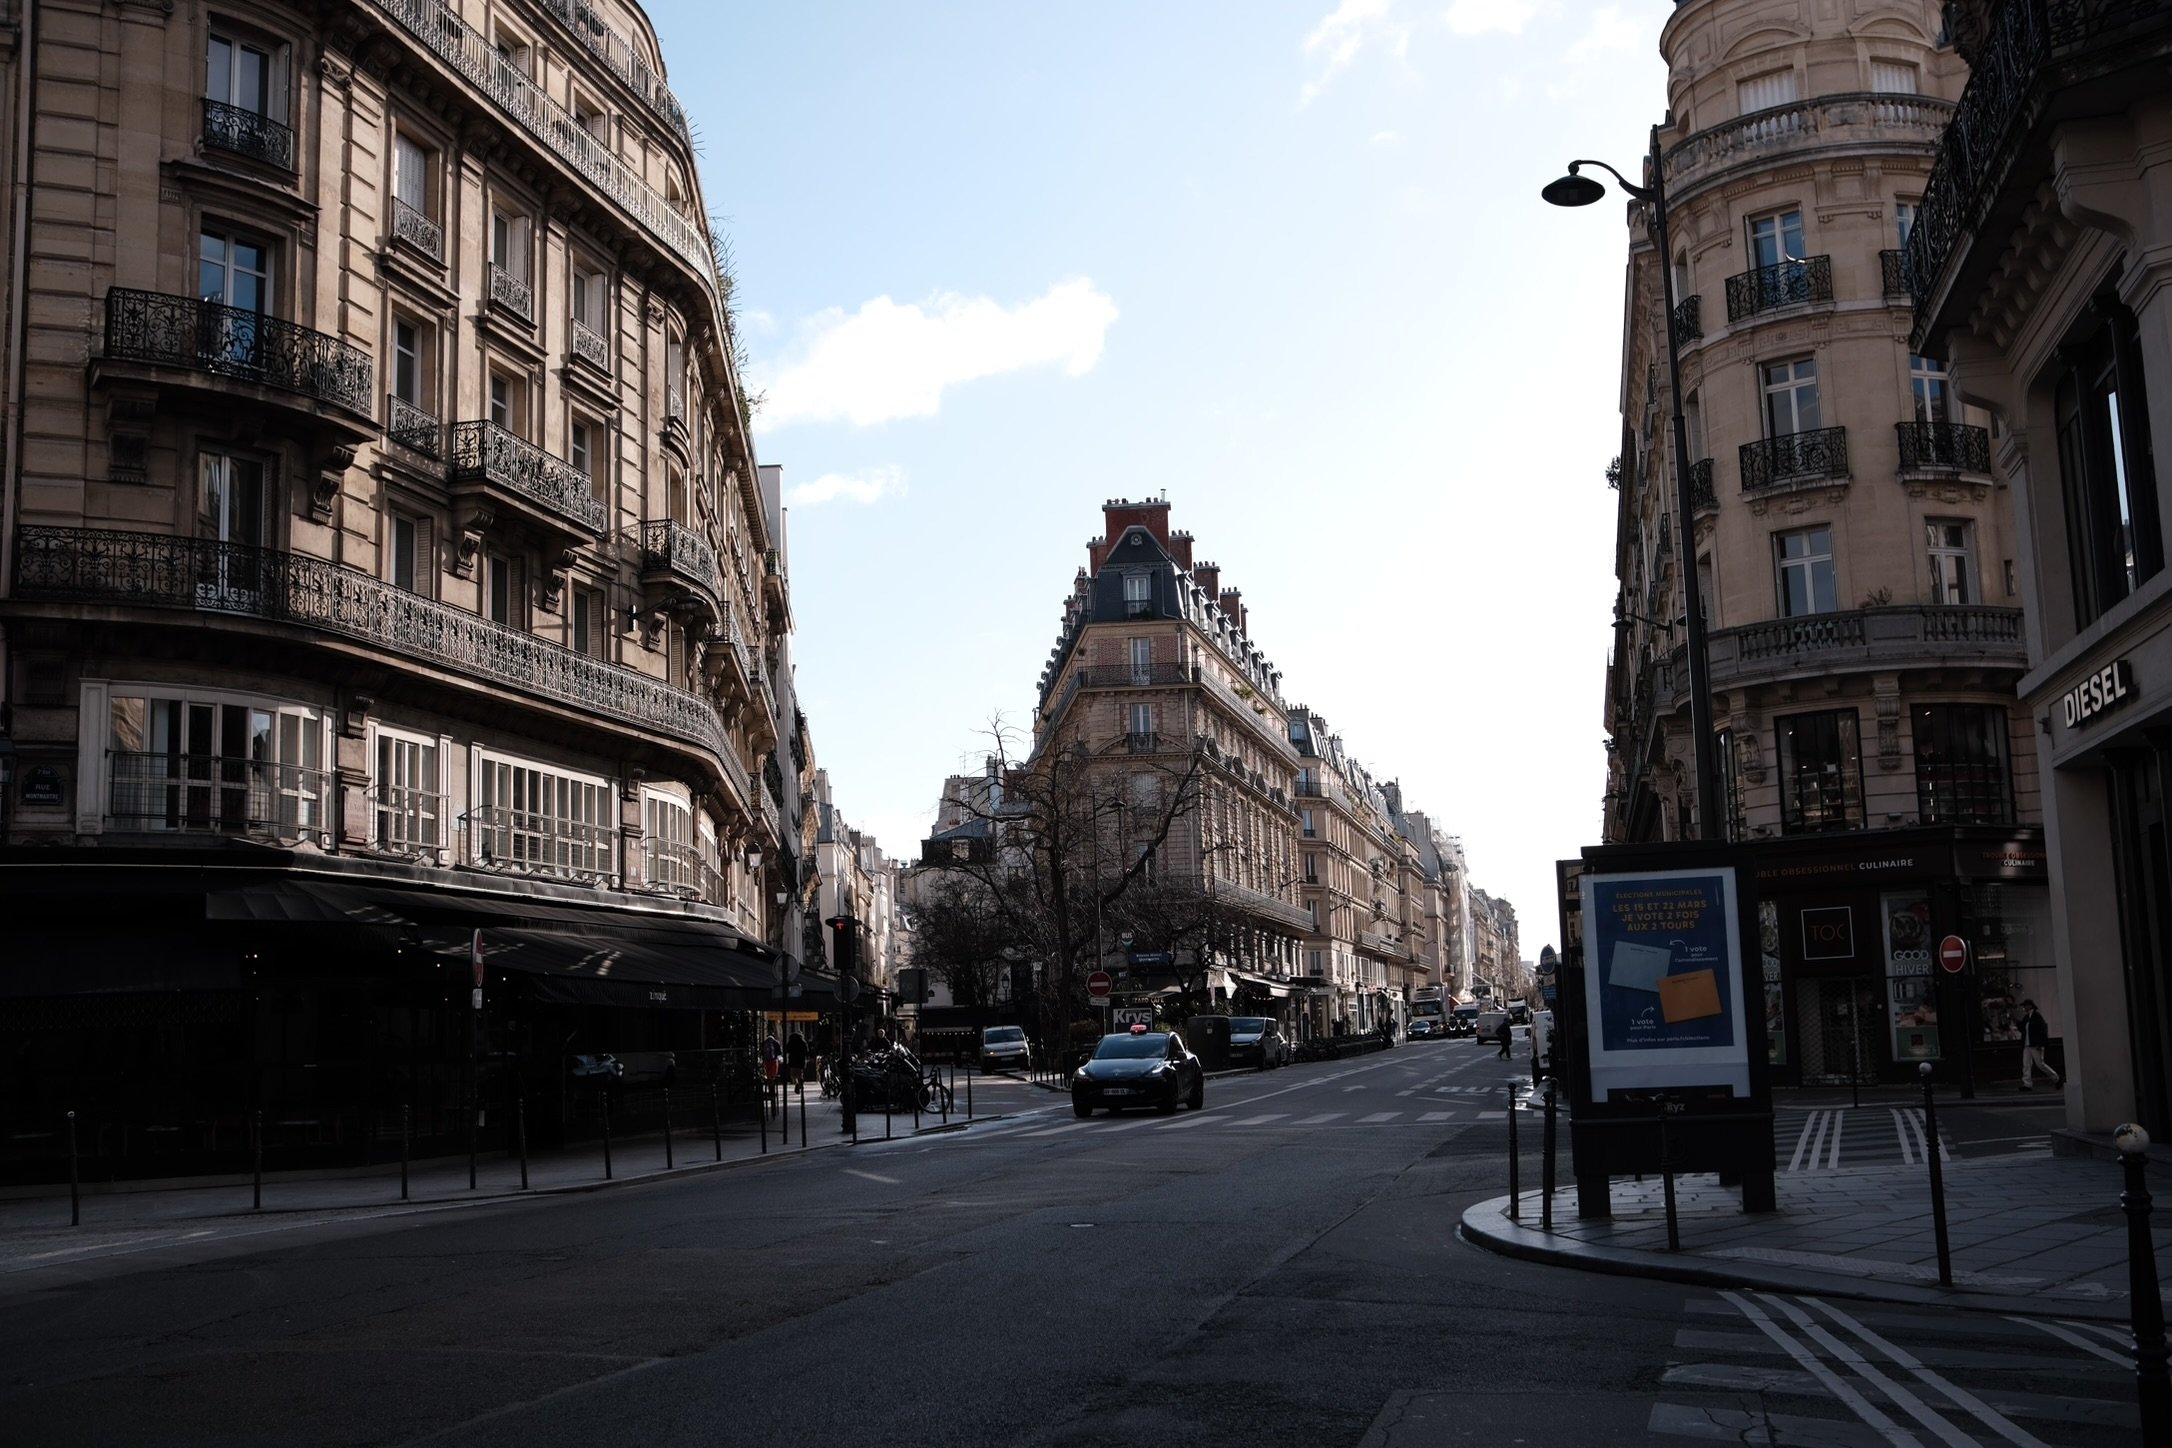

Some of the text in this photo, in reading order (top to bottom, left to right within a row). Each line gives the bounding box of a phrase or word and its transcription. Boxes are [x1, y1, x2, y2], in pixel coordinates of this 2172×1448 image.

[2064, 662, 2126, 728] DIESEL
[1780, 863, 1856, 877] OBSESSIONNEL
[1858, 858, 1913, 870] CULINAIRE
[2003, 859, 2035, 867] CULINAIRE
[1655, 888, 1703, 897] MUNICIPALES
[1612, 899, 1707, 912] LES 15 ET 22 MARS
[1621, 910, 1700, 922] JE VOTE 2 FOIS
[1627, 921, 1695, 932] AUX 2 TOURS
[1809, 923, 1846, 942] TOC
[1893, 950, 1929, 961] GOOD
[1895, 963, 1929, 975] HIVER
[1113, 1009, 1151, 1024] Krys
